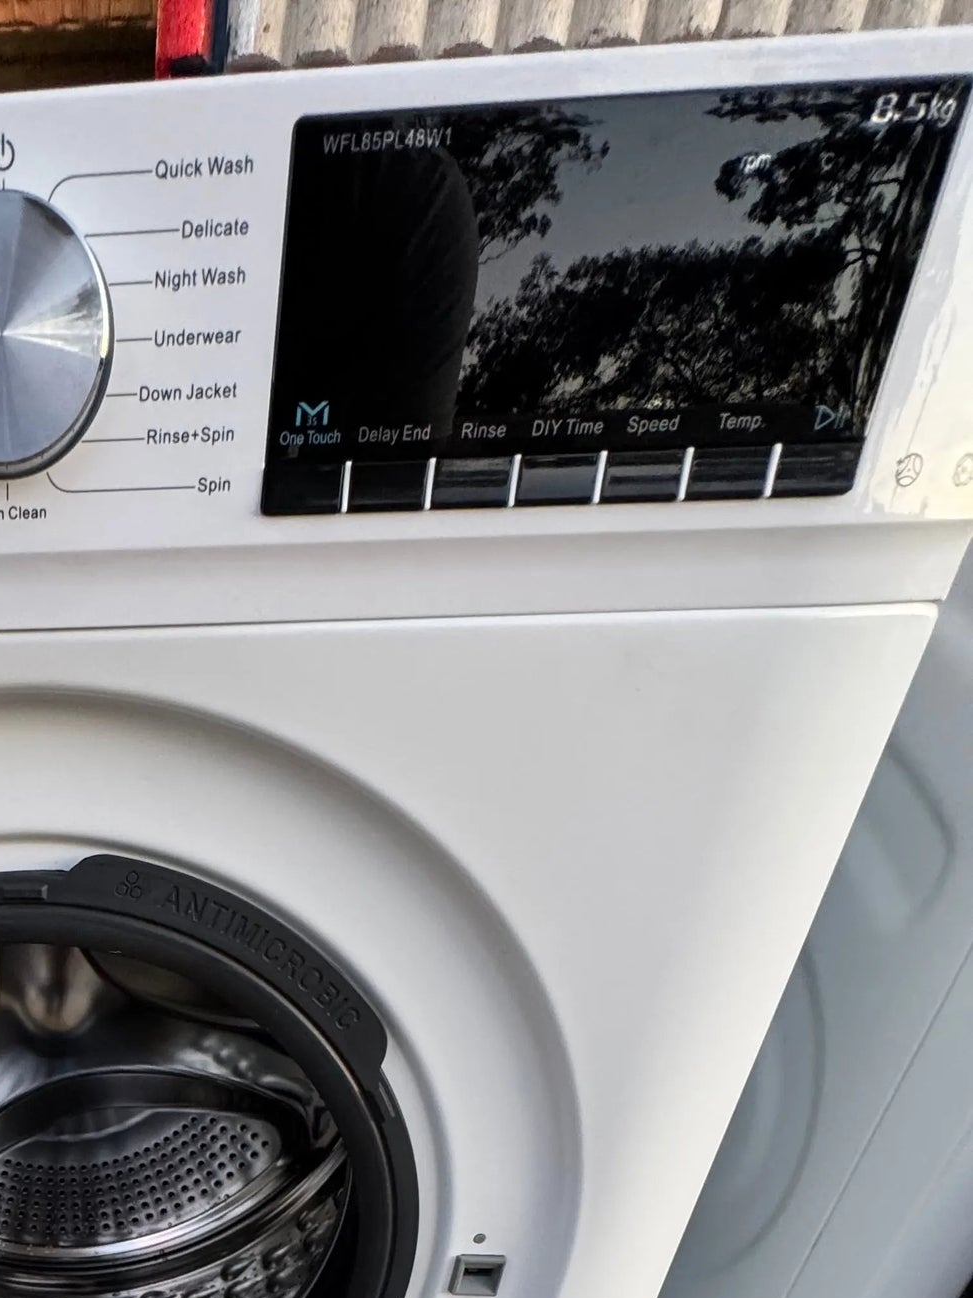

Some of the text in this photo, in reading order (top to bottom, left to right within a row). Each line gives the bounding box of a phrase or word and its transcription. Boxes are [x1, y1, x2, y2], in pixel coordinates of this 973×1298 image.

[323, 126, 452, 154] WFL85PL48W1
[154, 156, 255, 180] Quick Wash
[740, 152, 772, 174] rpm
[181, 218, 250, 239] Delicate
[154, 267, 246, 292] Night Wash
[153, 328, 242, 347] Underwear
[139, 383, 238, 401] Down Jacket
[461, 422, 507, 440] Rinse
[531, 418, 604, 437] DIY Time
[627, 415, 681, 437] Speed
[719, 412, 766, 433] Temp.
[146, 427, 236, 447] Rinse+Spin
[279, 428, 342, 446] One Touch
[358, 424, 432, 446] Delay End
[197, 476, 232, 498] Spin
[8, 504, 47, 520] Clean
